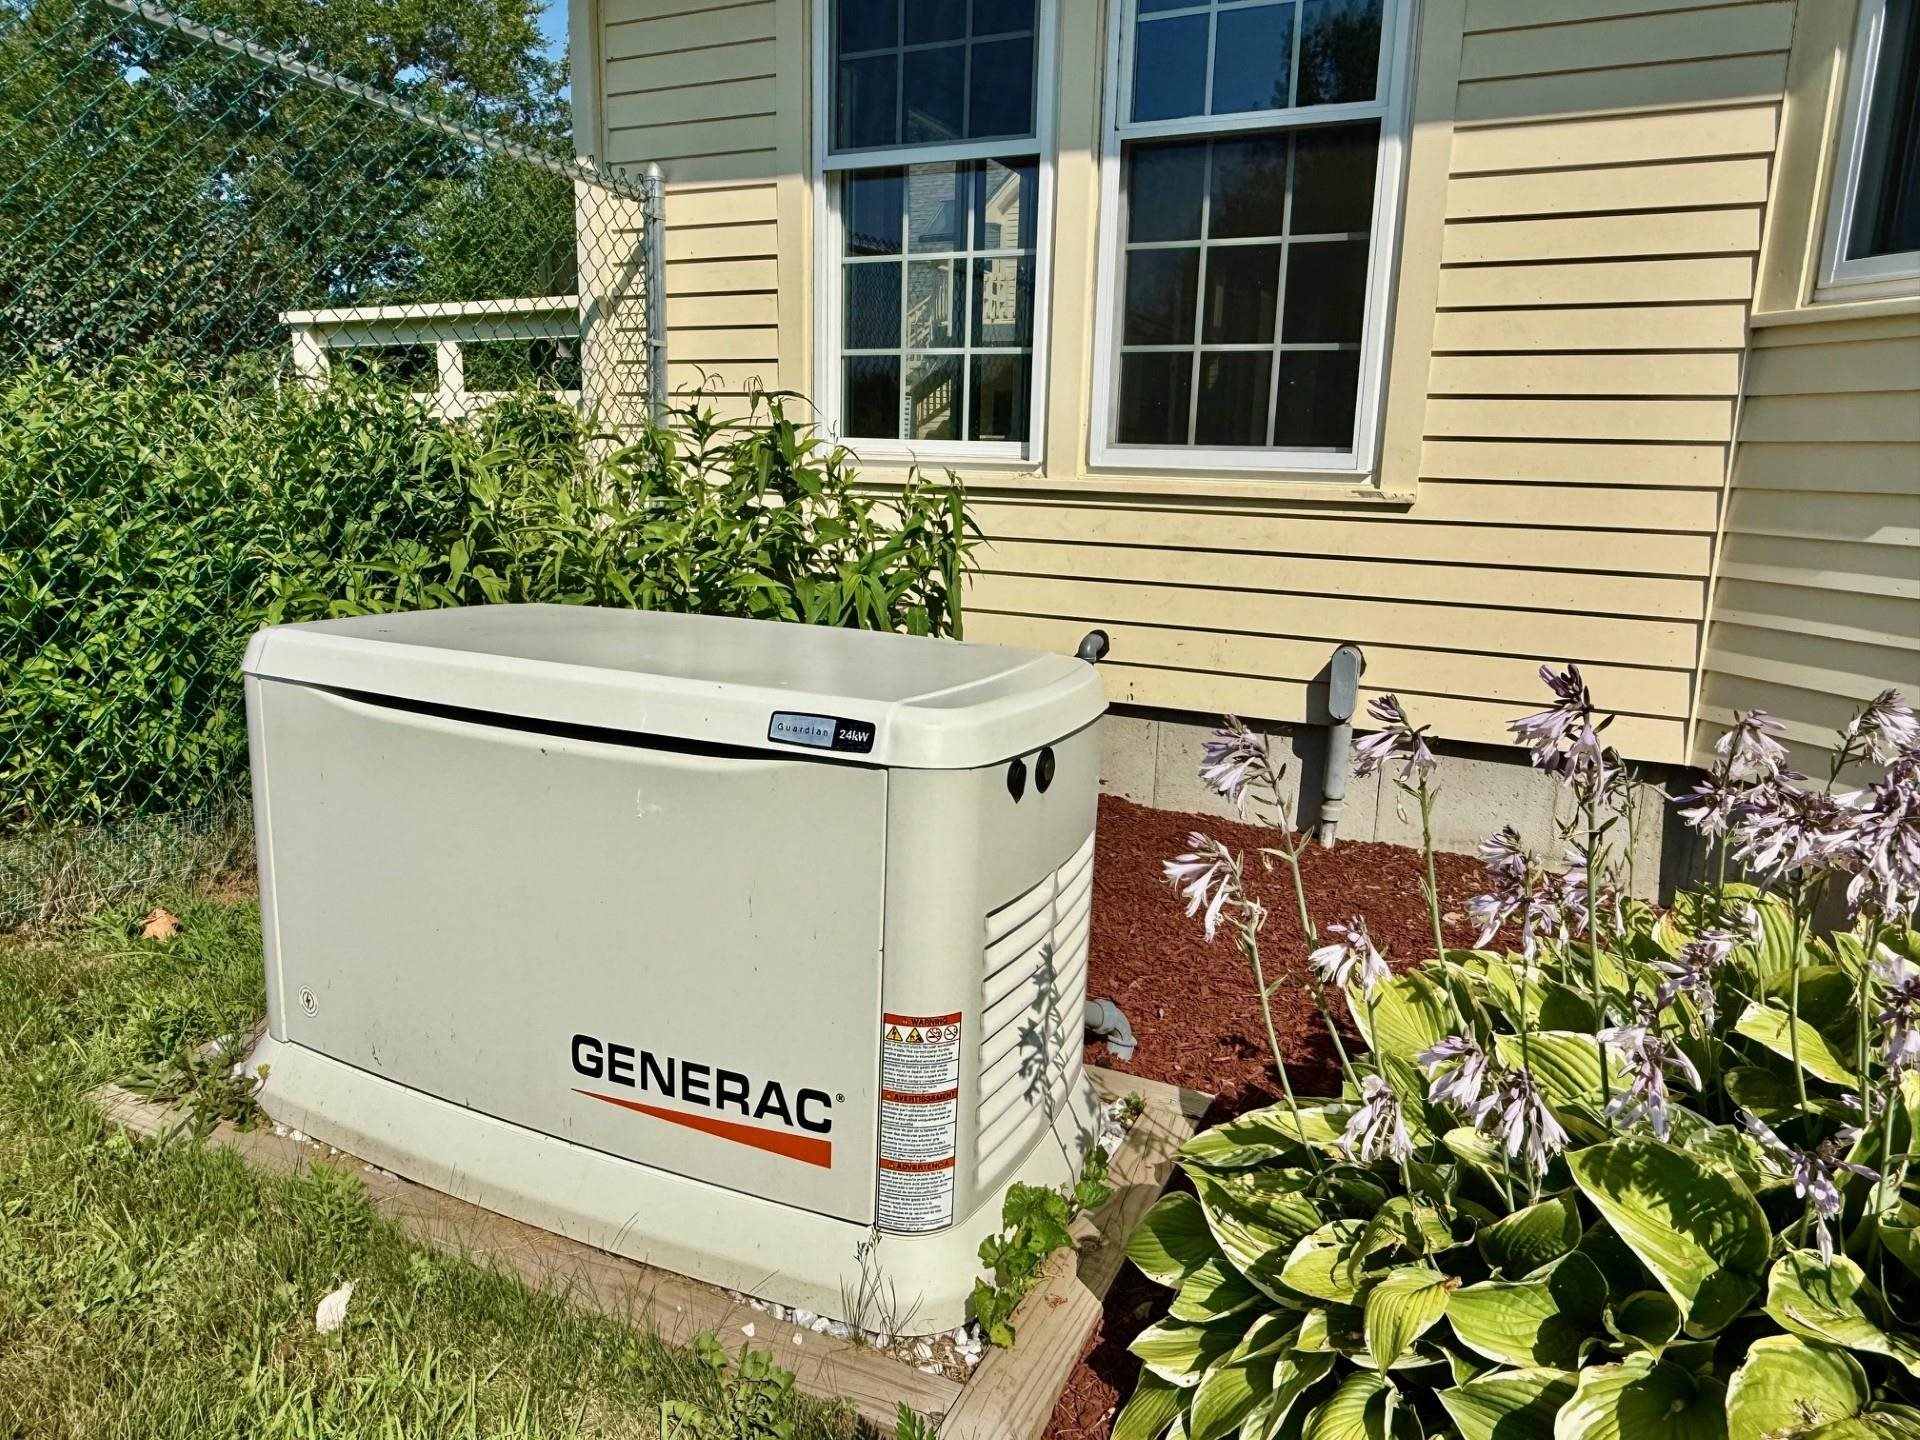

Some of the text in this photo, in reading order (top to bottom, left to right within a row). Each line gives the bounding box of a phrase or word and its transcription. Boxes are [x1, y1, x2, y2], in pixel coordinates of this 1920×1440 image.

[777, 722, 870, 742] Guardian 24kW
[911, 1017, 948, 1027] WARNING
